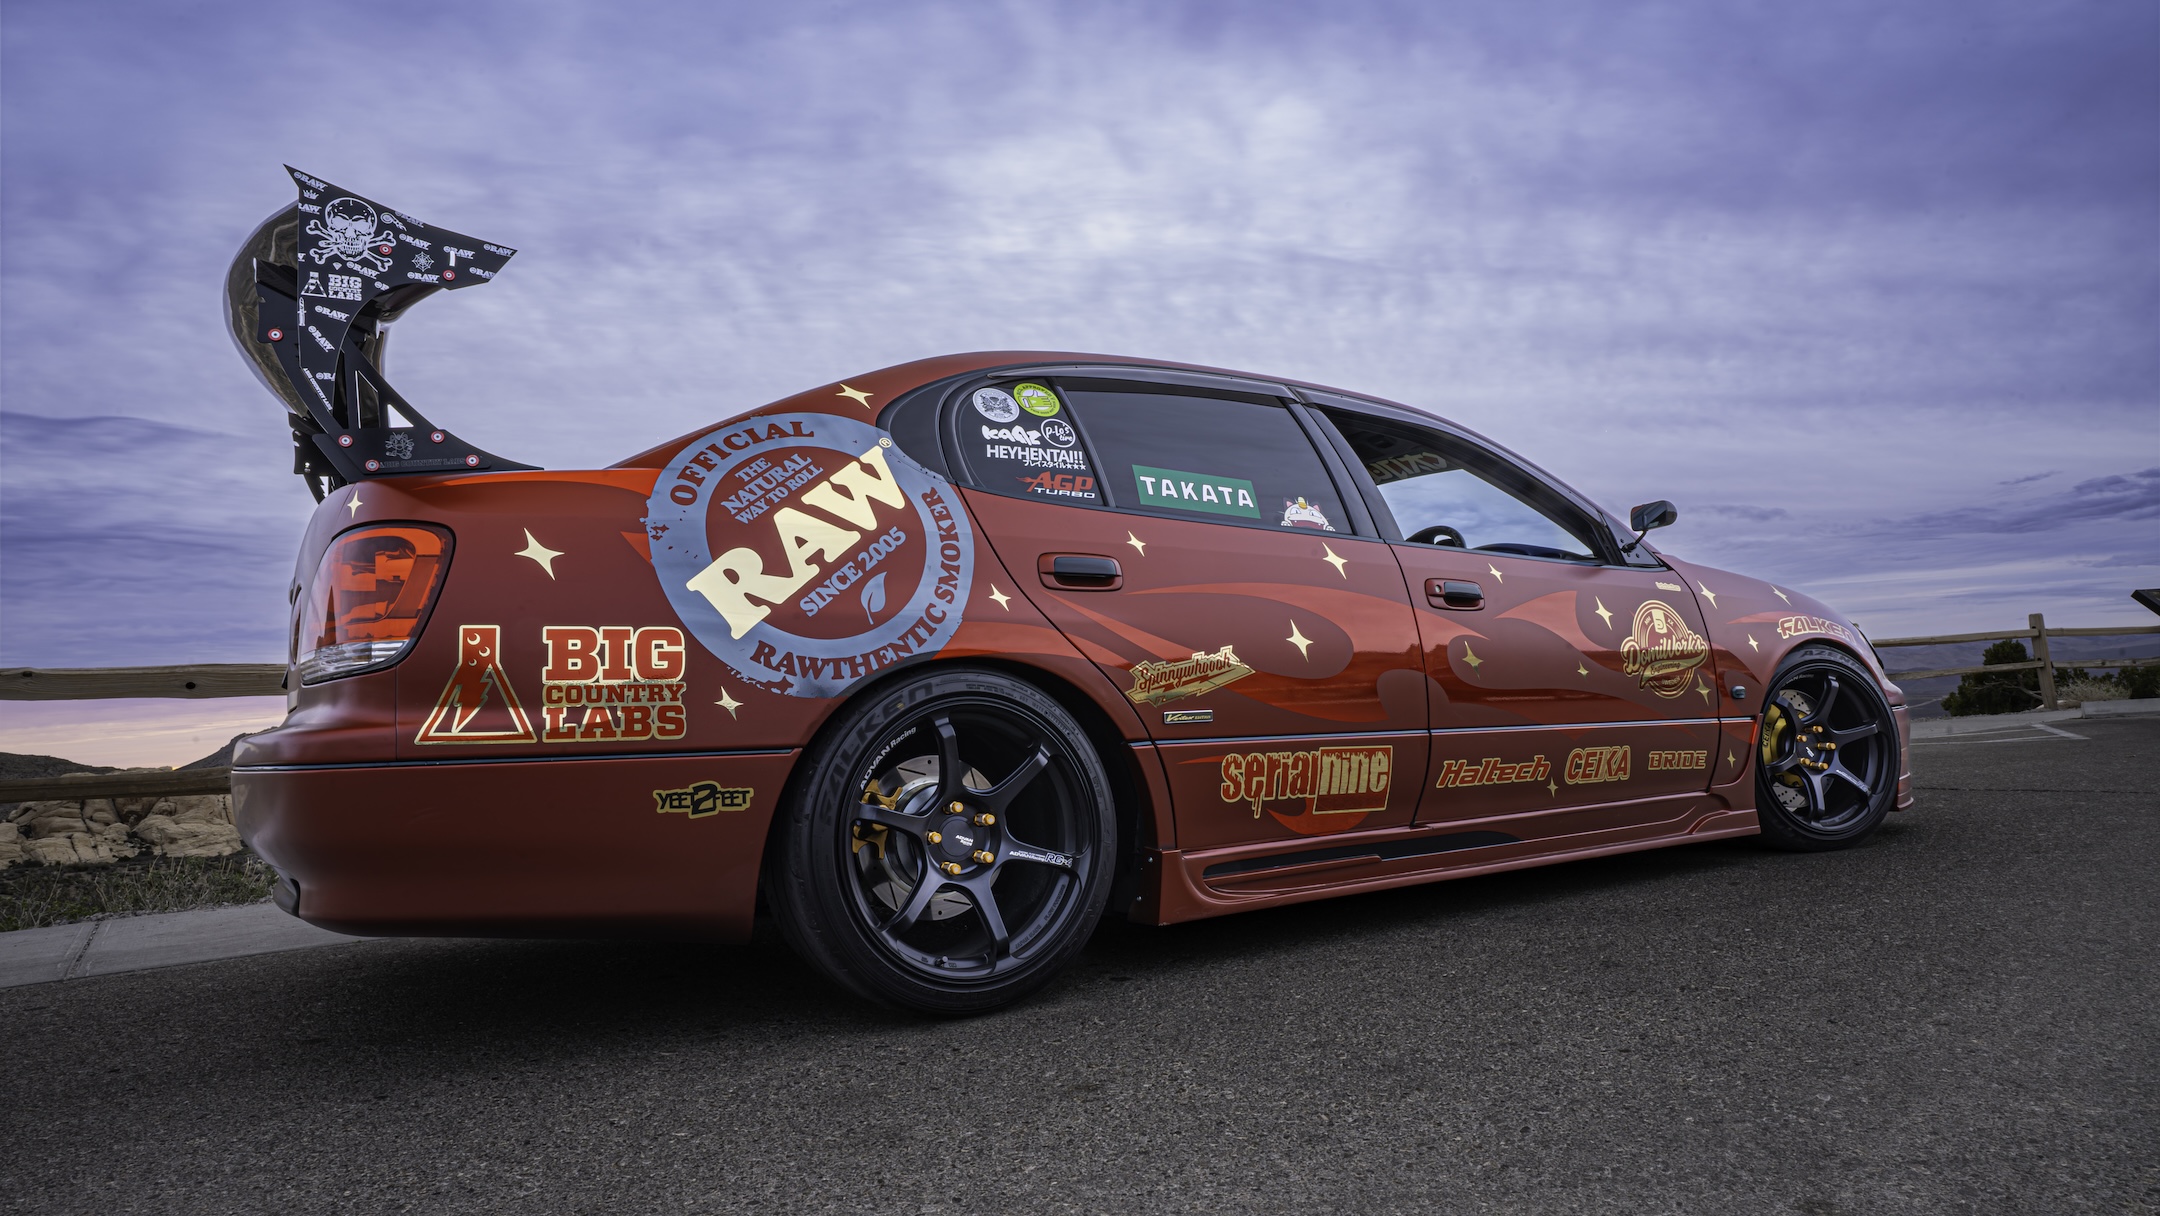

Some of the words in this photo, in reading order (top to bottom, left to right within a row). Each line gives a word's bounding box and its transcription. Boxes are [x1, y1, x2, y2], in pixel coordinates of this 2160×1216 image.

[300, 174, 328, 190] RAW
[406, 236, 431, 249] RAW
[488, 245, 514, 256] RAW
[328, 274, 362, 288] BIG
[353, 263, 380, 279] RAW
[414, 273, 440, 282] RAW
[328, 291, 362, 301] LABS
[322, 307, 350, 321] RAW
[312, 330, 336, 351] RAW
[670, 421, 815, 506] OFFICIAL
[986, 444, 1083, 464] HEYHENTAI!!
[734, 457, 772, 483] THE
[1018, 471, 1094, 493] AGP
[720, 453, 812, 515] NATURAL
[734, 497, 770, 525] WAY
[766, 485, 789, 507] TO
[787, 464, 824, 495] ROLL
[1034, 487, 1096, 499] TURBO
[1139, 475, 1255, 508] TAKATA
[685, 445, 905, 640] RAW
[750, 603, 947, 680] RAWTHENTIC
[920, 486, 961, 605] SMOKER
[800, 561, 863, 617] SINCE
[857, 526, 907, 572] 2005
[1777, 615, 1856, 645] FALKEN
[542, 625, 686, 684] BIG
[1623, 635, 1704, 673] DomiWorks
[1139, 652, 1232, 694] Spinnywhoosh
[543, 683, 686, 706] COUNTRY
[542, 704, 687, 743] LABS
[860, 745, 891, 791] ADVAN
[890, 726, 916, 748] Racing
[1436, 755, 1551, 788] Haltech
[1648, 751, 1708, 770] BRIDE
